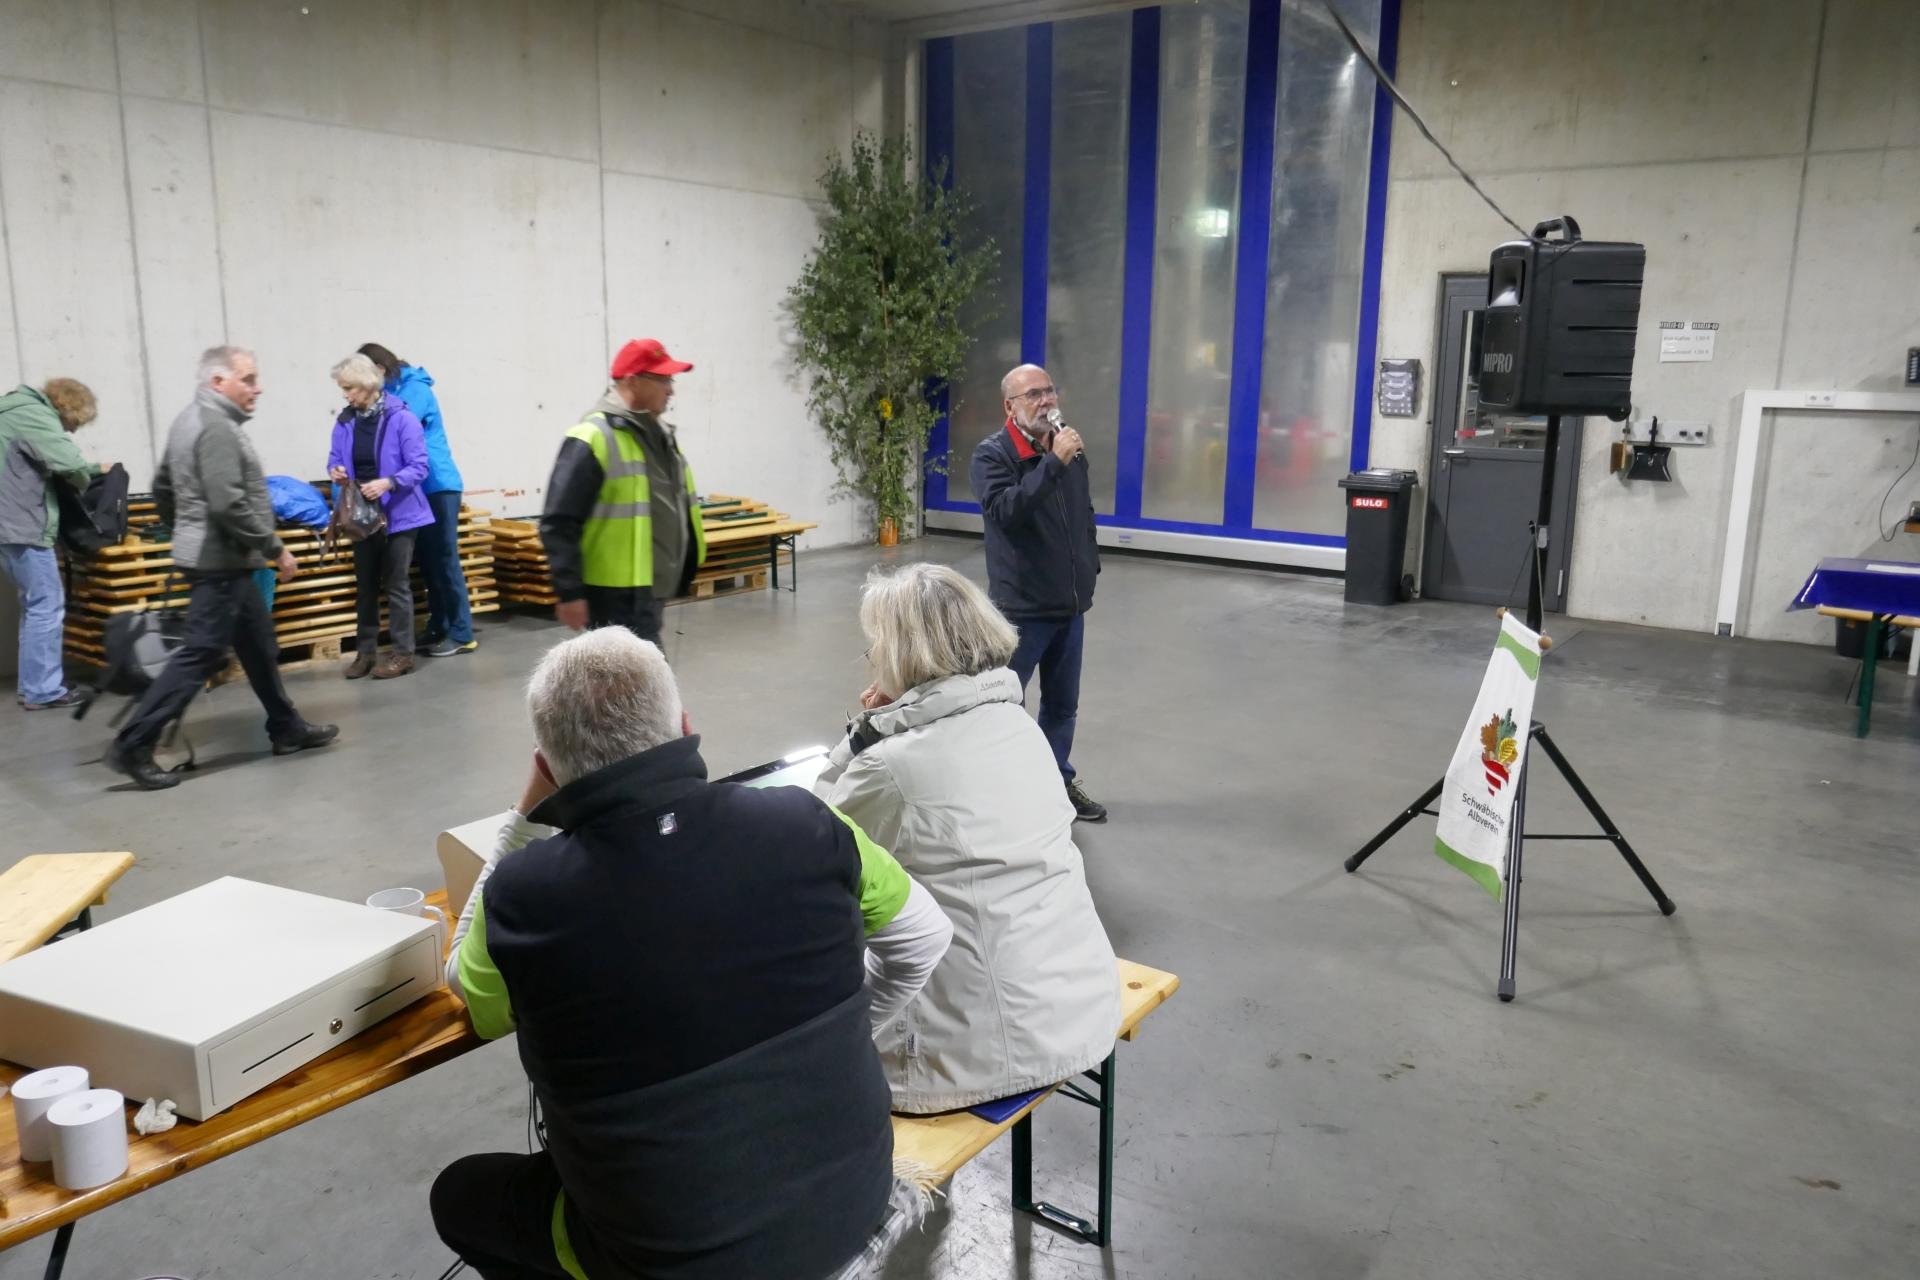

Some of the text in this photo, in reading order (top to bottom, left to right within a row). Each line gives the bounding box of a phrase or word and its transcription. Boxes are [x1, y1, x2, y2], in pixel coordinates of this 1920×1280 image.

[1483, 353, 1513, 373] MIPRO
[1355, 498, 1383, 507] SULO
[1468, 808, 1499, 836] Albverein
